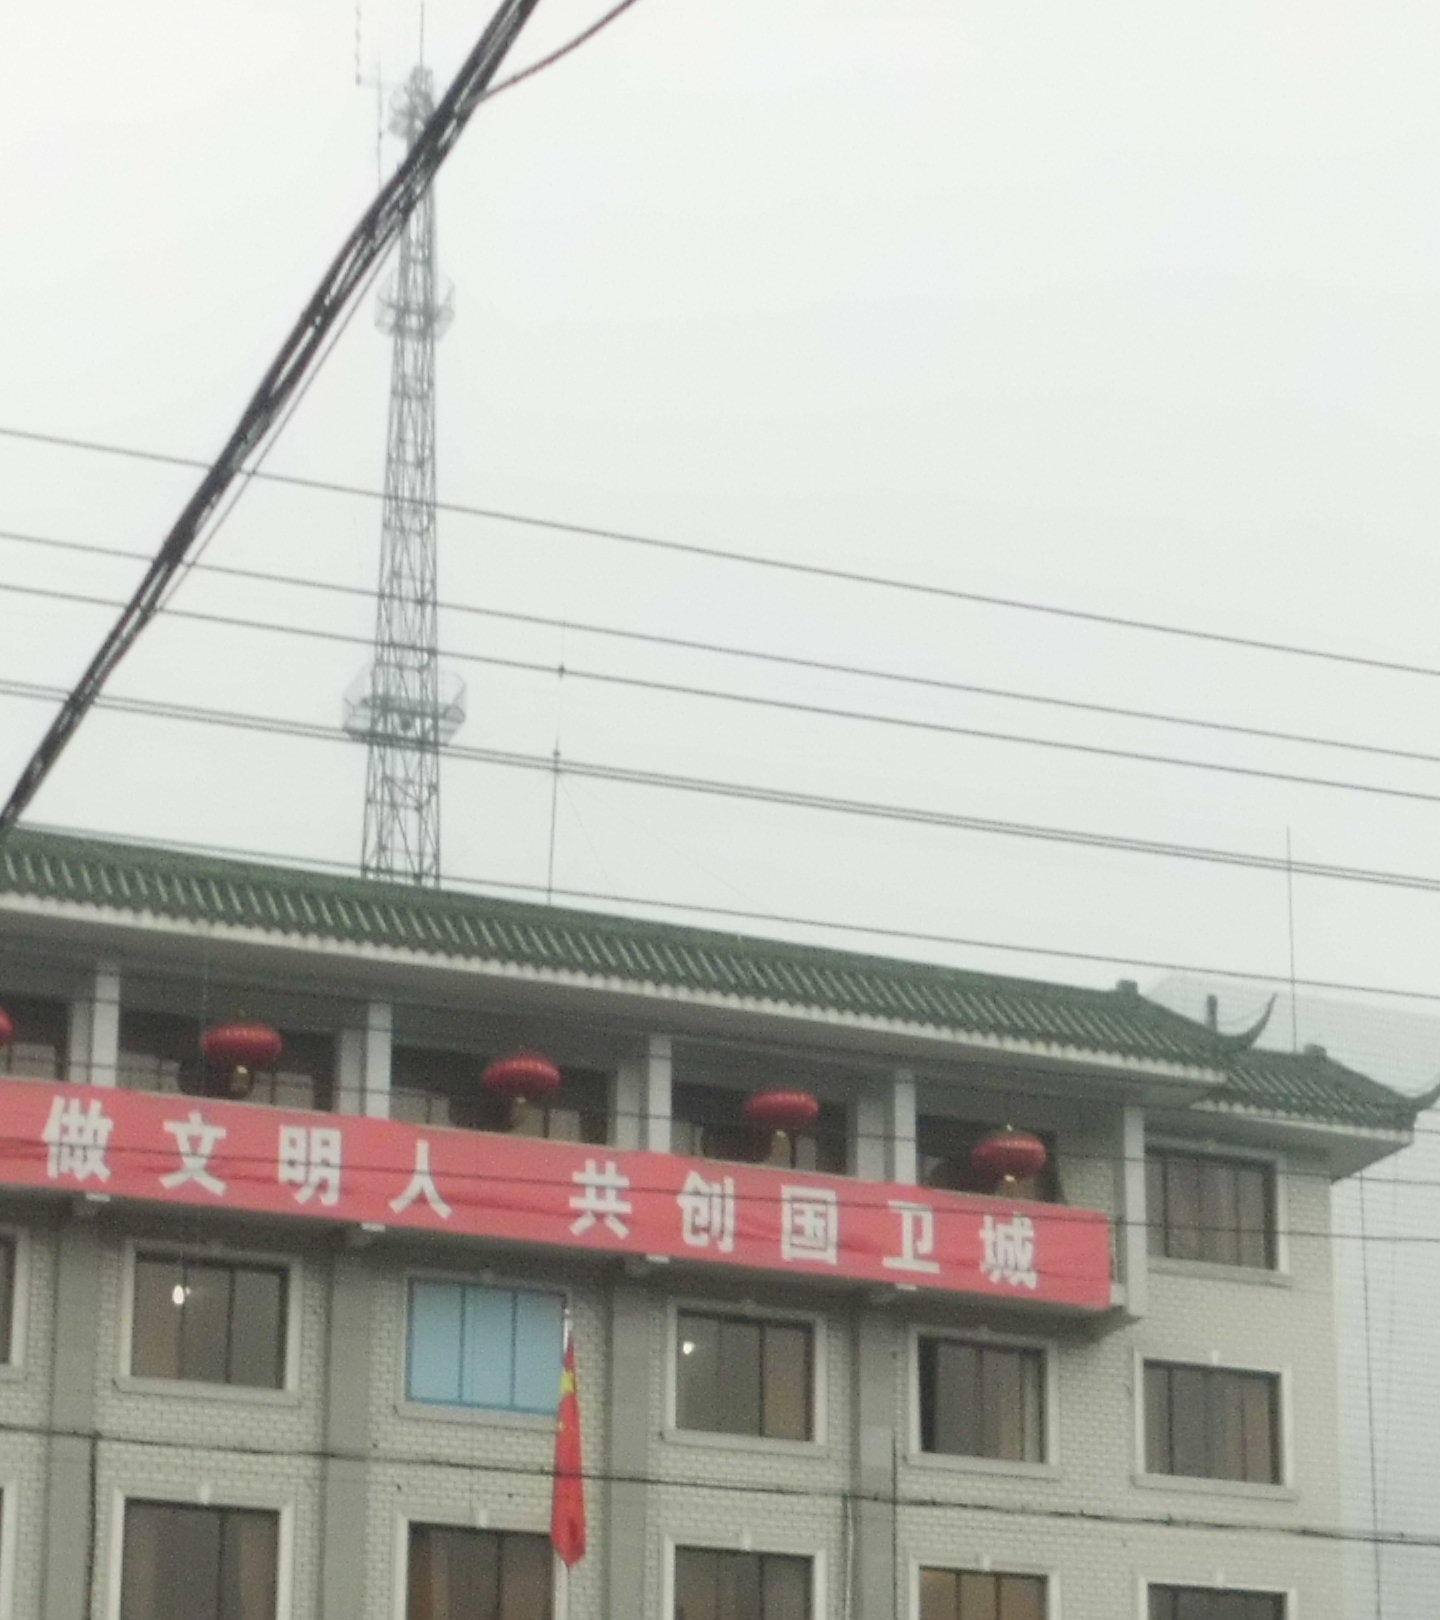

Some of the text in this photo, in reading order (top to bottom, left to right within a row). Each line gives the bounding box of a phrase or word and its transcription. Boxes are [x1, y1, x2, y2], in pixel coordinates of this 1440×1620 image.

[568, 1158, 1038, 1292] 共创国卫城
